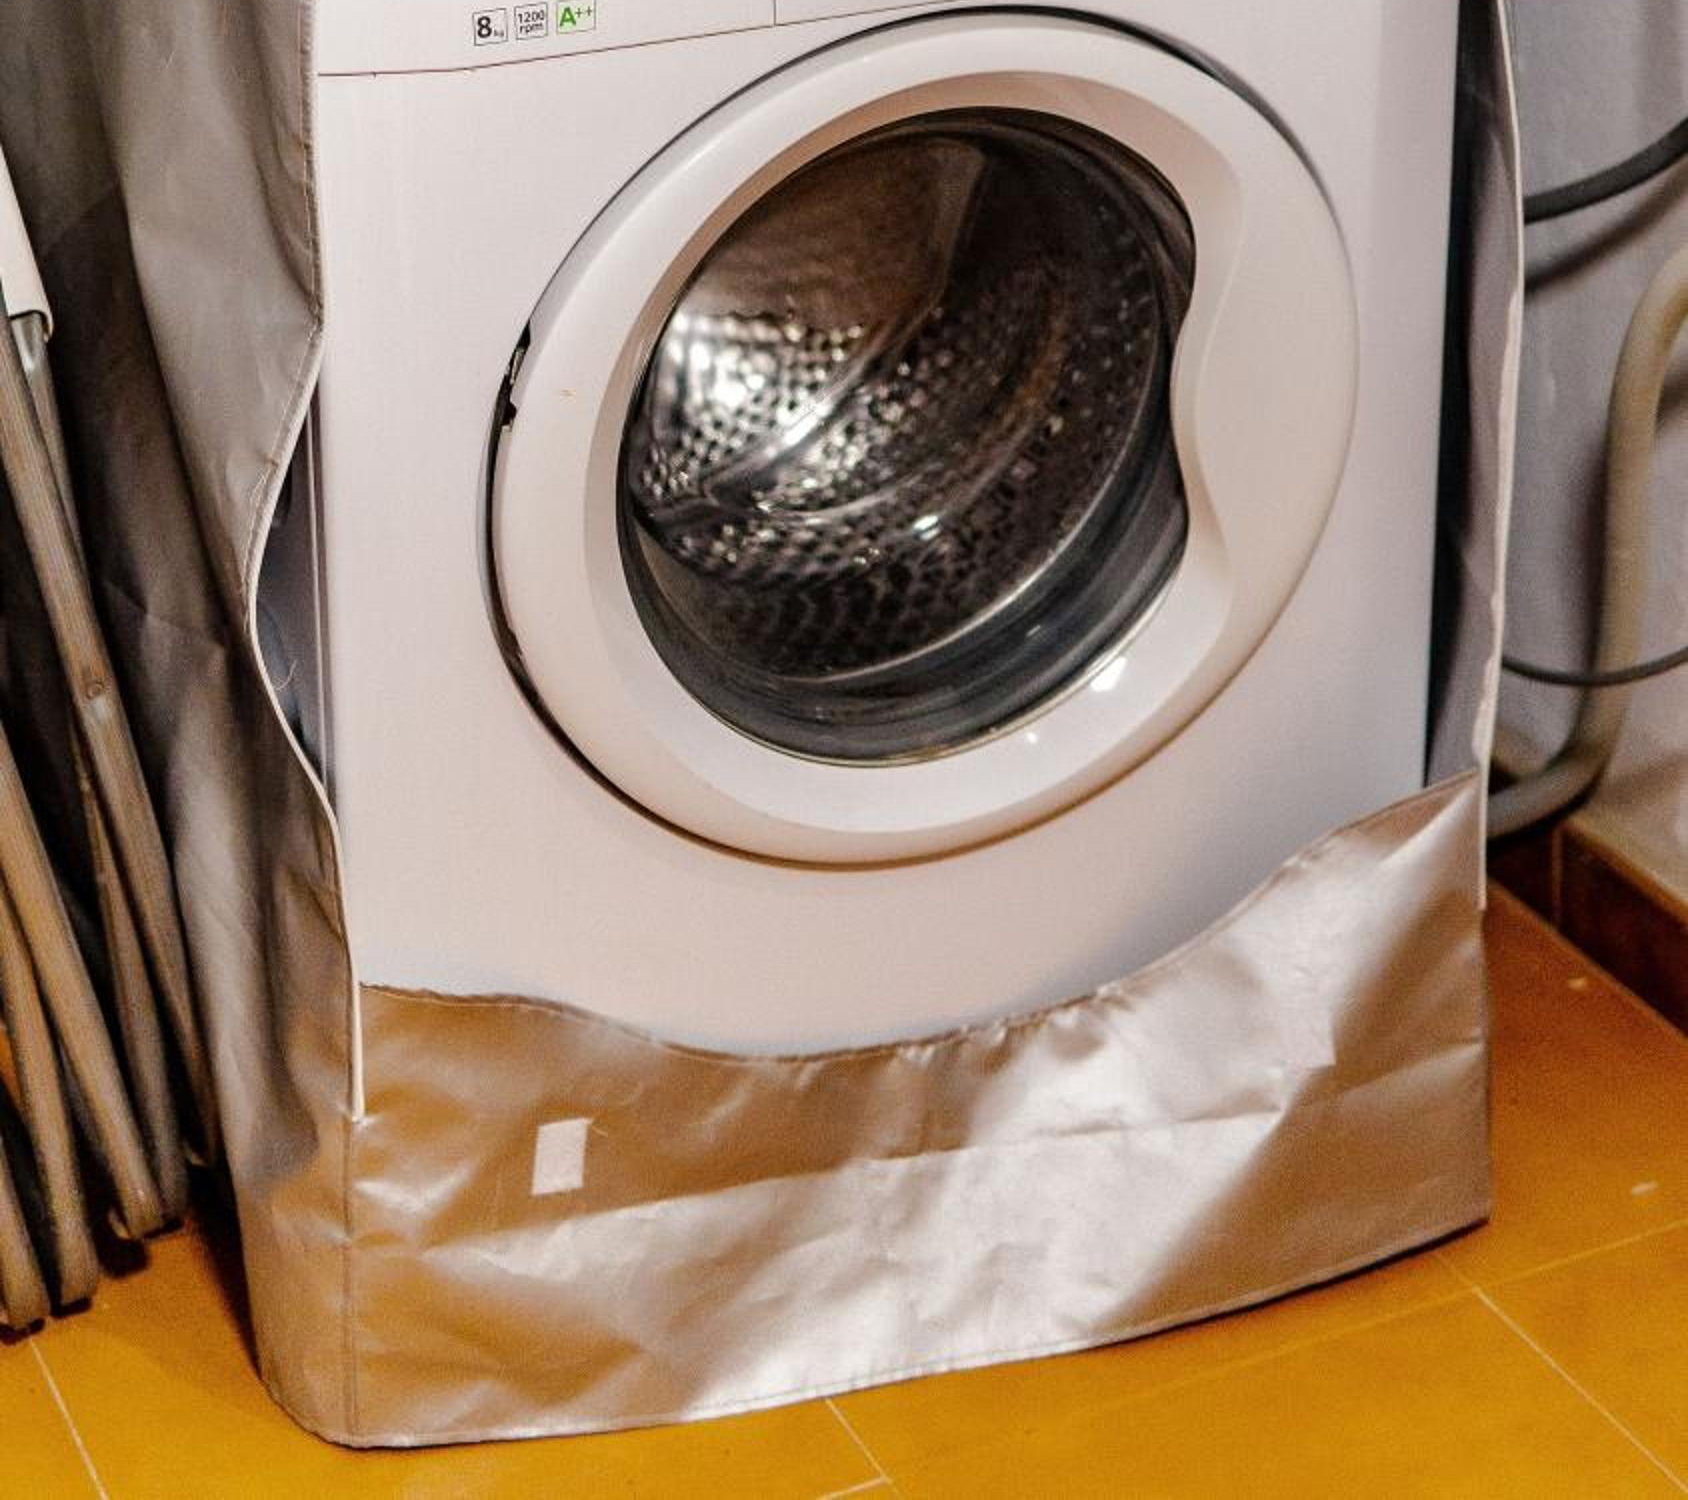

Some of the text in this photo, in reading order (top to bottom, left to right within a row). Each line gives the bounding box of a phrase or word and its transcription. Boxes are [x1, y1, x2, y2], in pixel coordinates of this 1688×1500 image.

[518, 10, 544, 24] 1200
[560, 6, 593, 27] A++
[477, 16, 492, 38] 8
[519, 23, 544, 34] rpm
